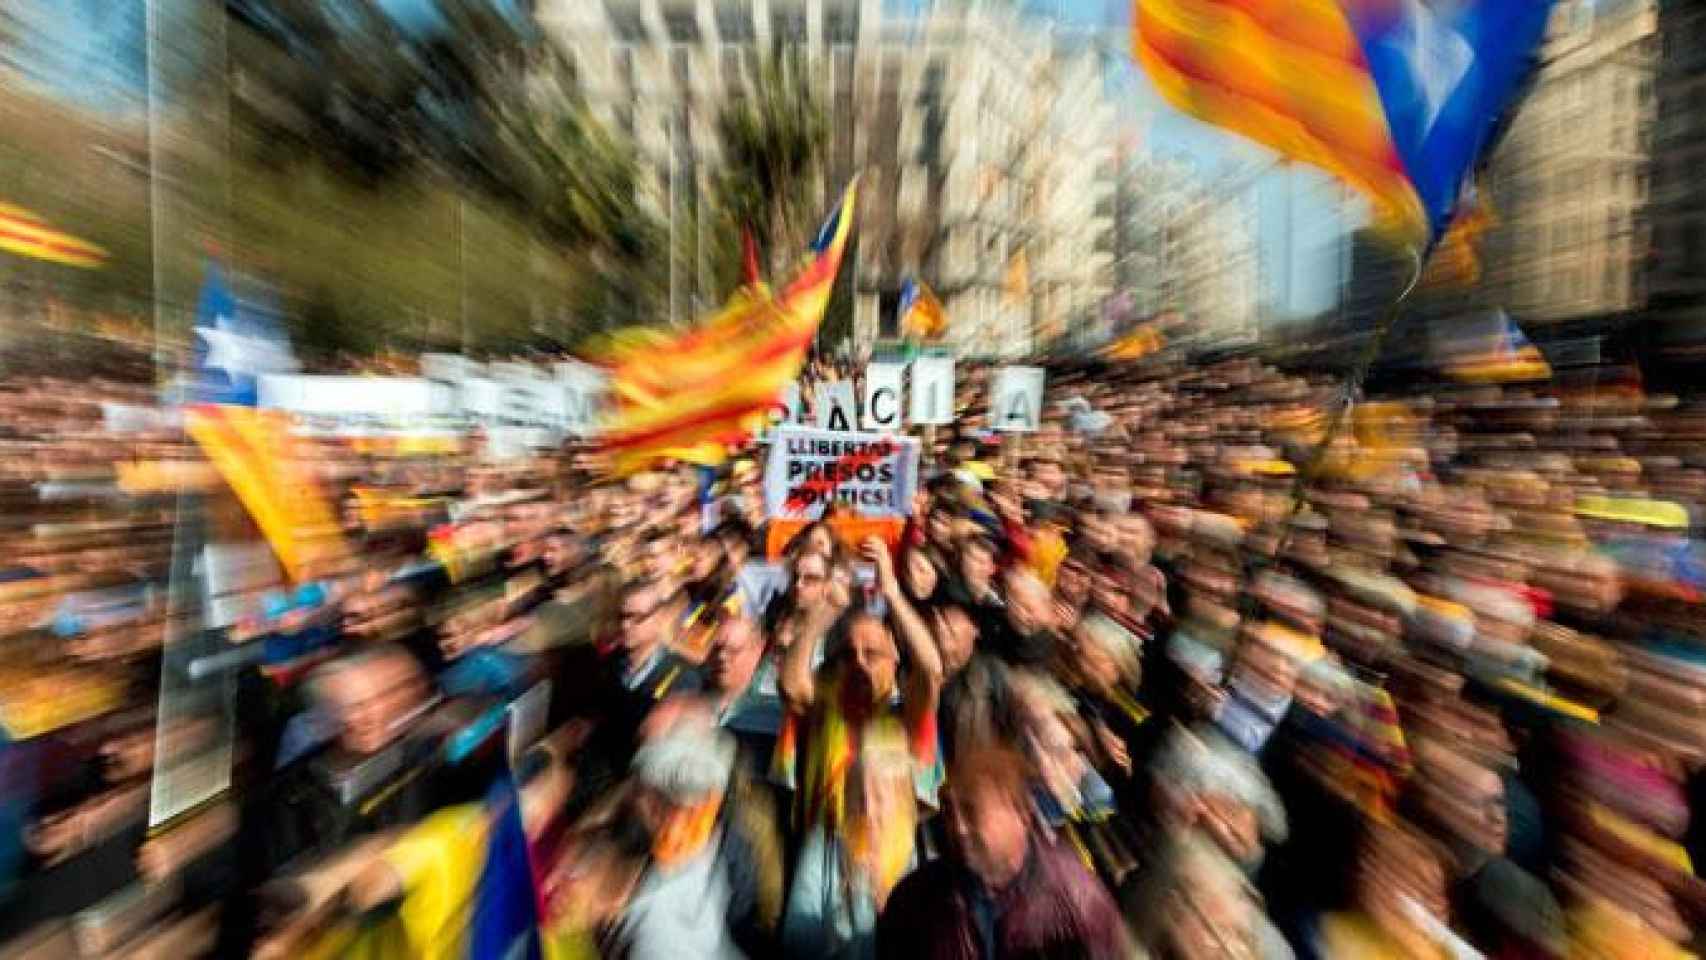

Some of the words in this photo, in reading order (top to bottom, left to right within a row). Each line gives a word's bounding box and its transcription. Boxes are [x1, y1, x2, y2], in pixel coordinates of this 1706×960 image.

[827, 396, 851, 431] A
[870, 386, 896, 424] C
[1007, 391, 1034, 428] A
[787, 460, 894, 482] PRESOS
